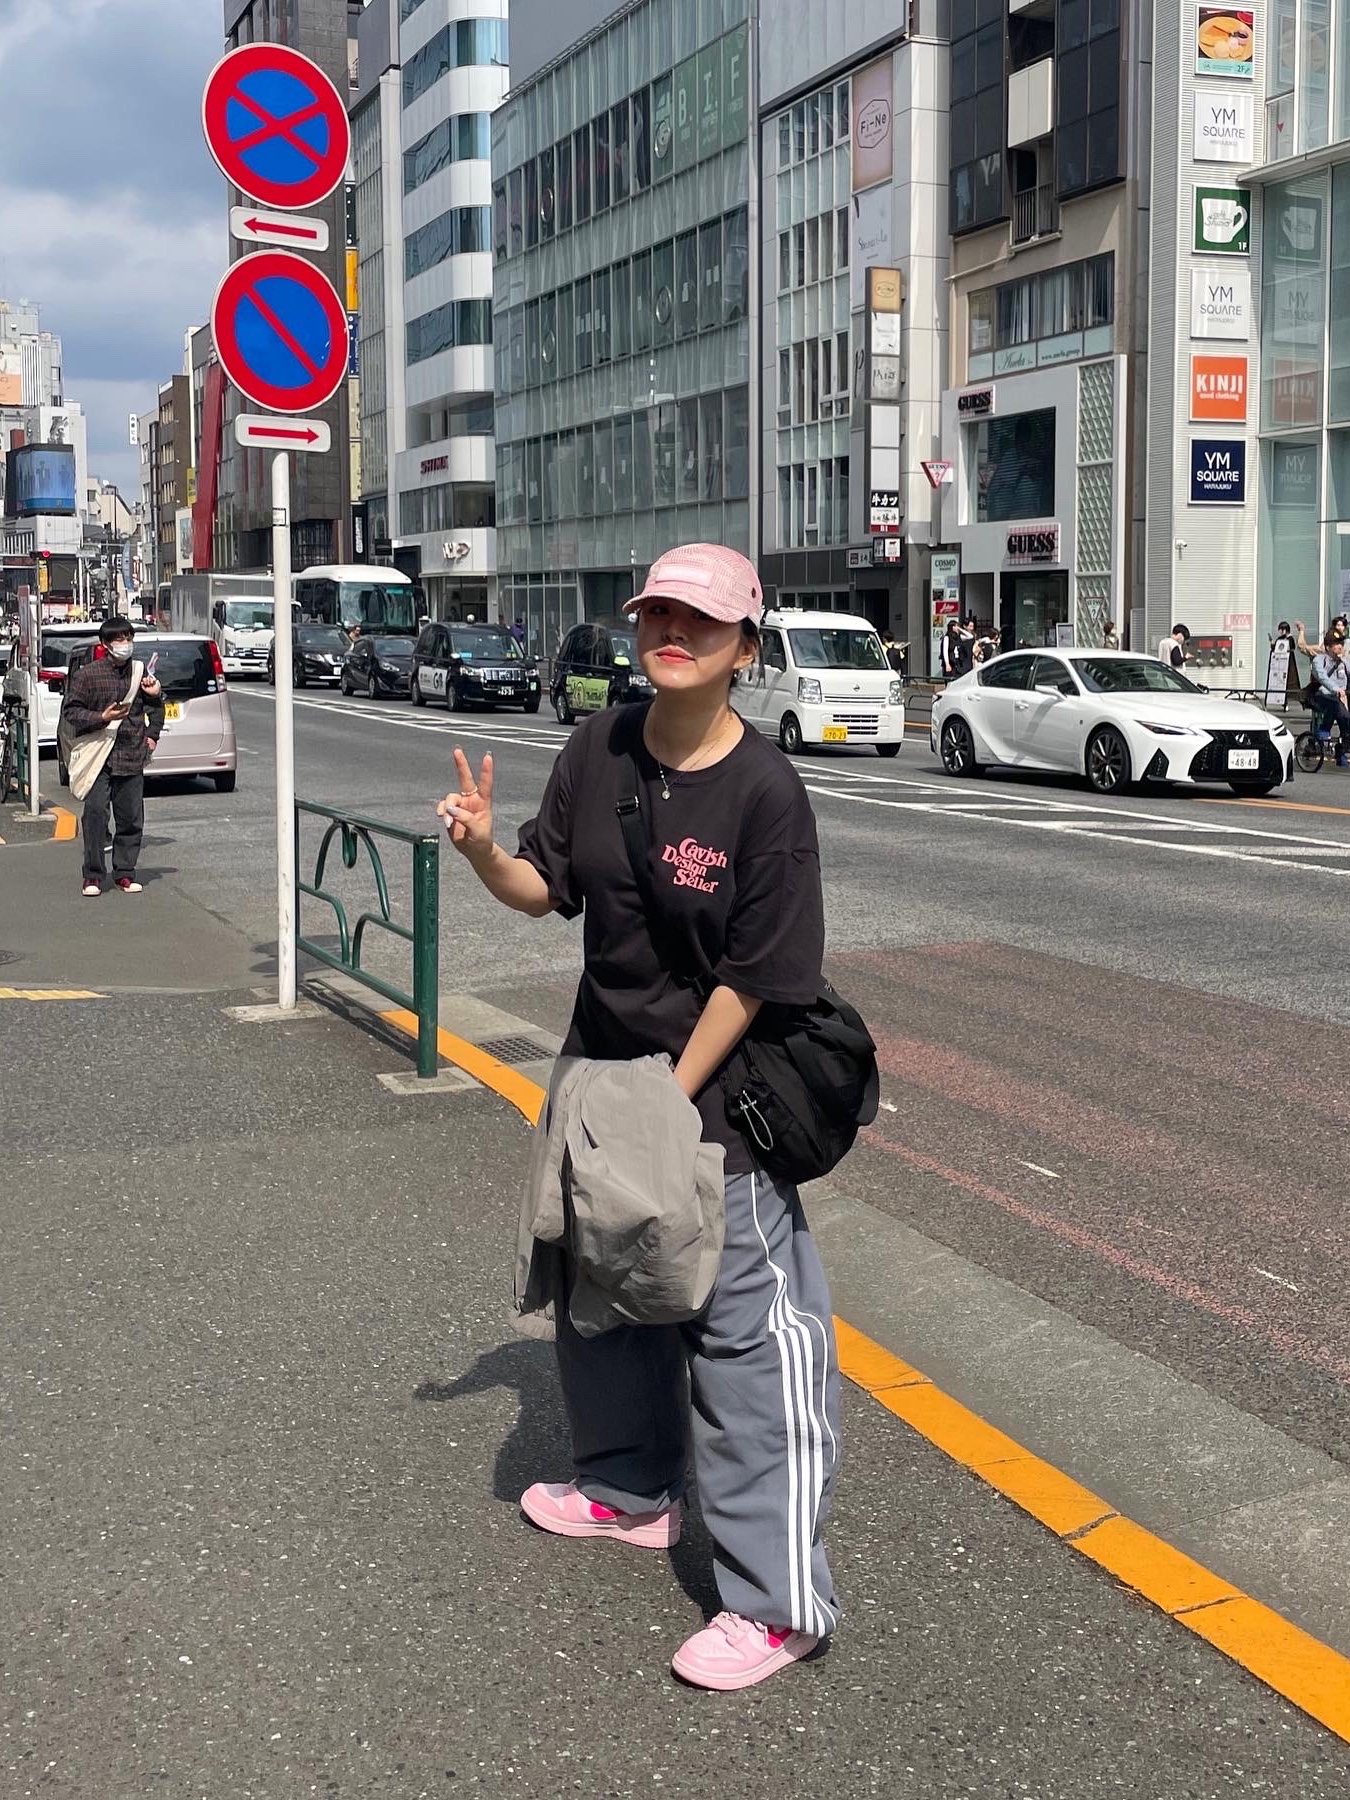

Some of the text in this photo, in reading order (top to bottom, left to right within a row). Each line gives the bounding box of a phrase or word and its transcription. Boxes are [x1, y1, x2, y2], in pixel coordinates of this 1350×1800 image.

[860, 113, 887, 134] Fi-Ne
[1211, 107, 1236, 125] YM
[1202, 126, 1246, 139] SQUARE
[1238, 241, 1247, 251] 1F
[1208, 285, 1233, 302] YM
[1200, 304, 1242, 316] SQUARE
[1196, 373, 1244, 394] KINJI
[958, 391, 991, 411] GUESS
[1215, 392, 1240, 402] clothing
[1204, 451, 1230, 470] YM
[1196, 470, 1240, 482] SQUARE
[872, 493, 898, 506] 牛カツ
[1007, 531, 1055, 554] GUESS
[934, 559, 957, 568] COSMO
[661, 844, 707, 877] Design
[679, 837, 728, 868] Cavish
[673, 868, 719, 893] Seller
